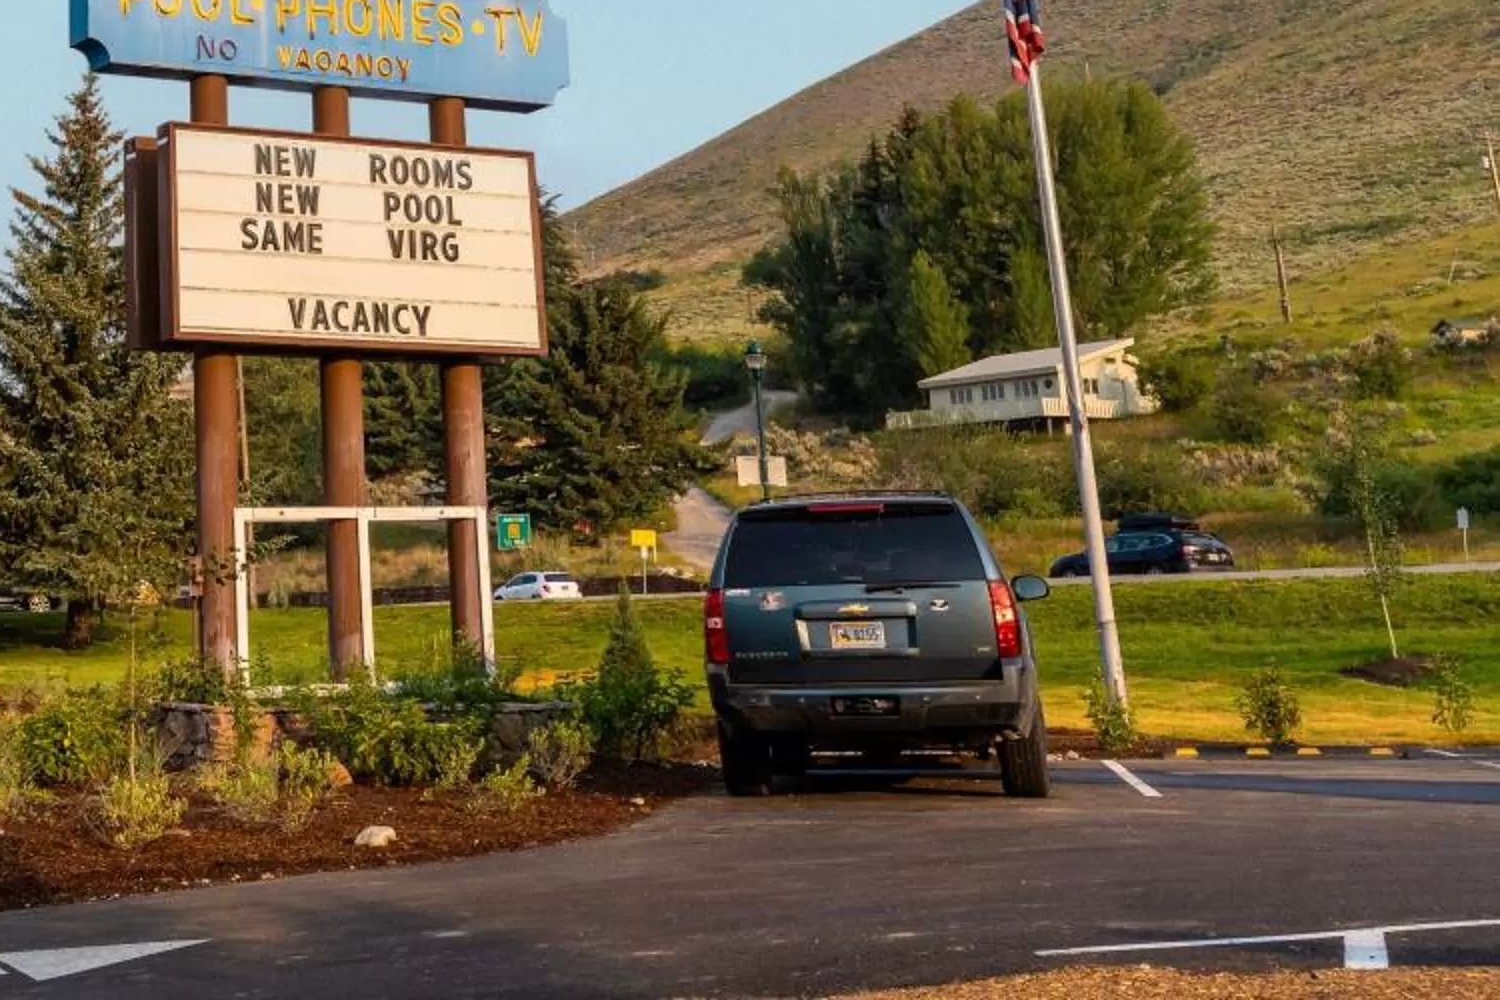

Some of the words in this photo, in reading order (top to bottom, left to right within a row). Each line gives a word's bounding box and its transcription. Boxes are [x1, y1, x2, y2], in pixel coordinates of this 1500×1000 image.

[484, 6, 543, 57] TV
[196, 34, 238, 61] NO
[275, 44, 412, 82] VACANCY
[254, 143, 317, 178] NEW
[369, 153, 473, 191] ROOMS
[255, 182, 320, 216] NEW
[384, 191, 462, 226] POOL
[241, 218, 323, 254] SAME
[386, 229, 460, 263] VIRG
[287, 298, 431, 337] VACANCY
